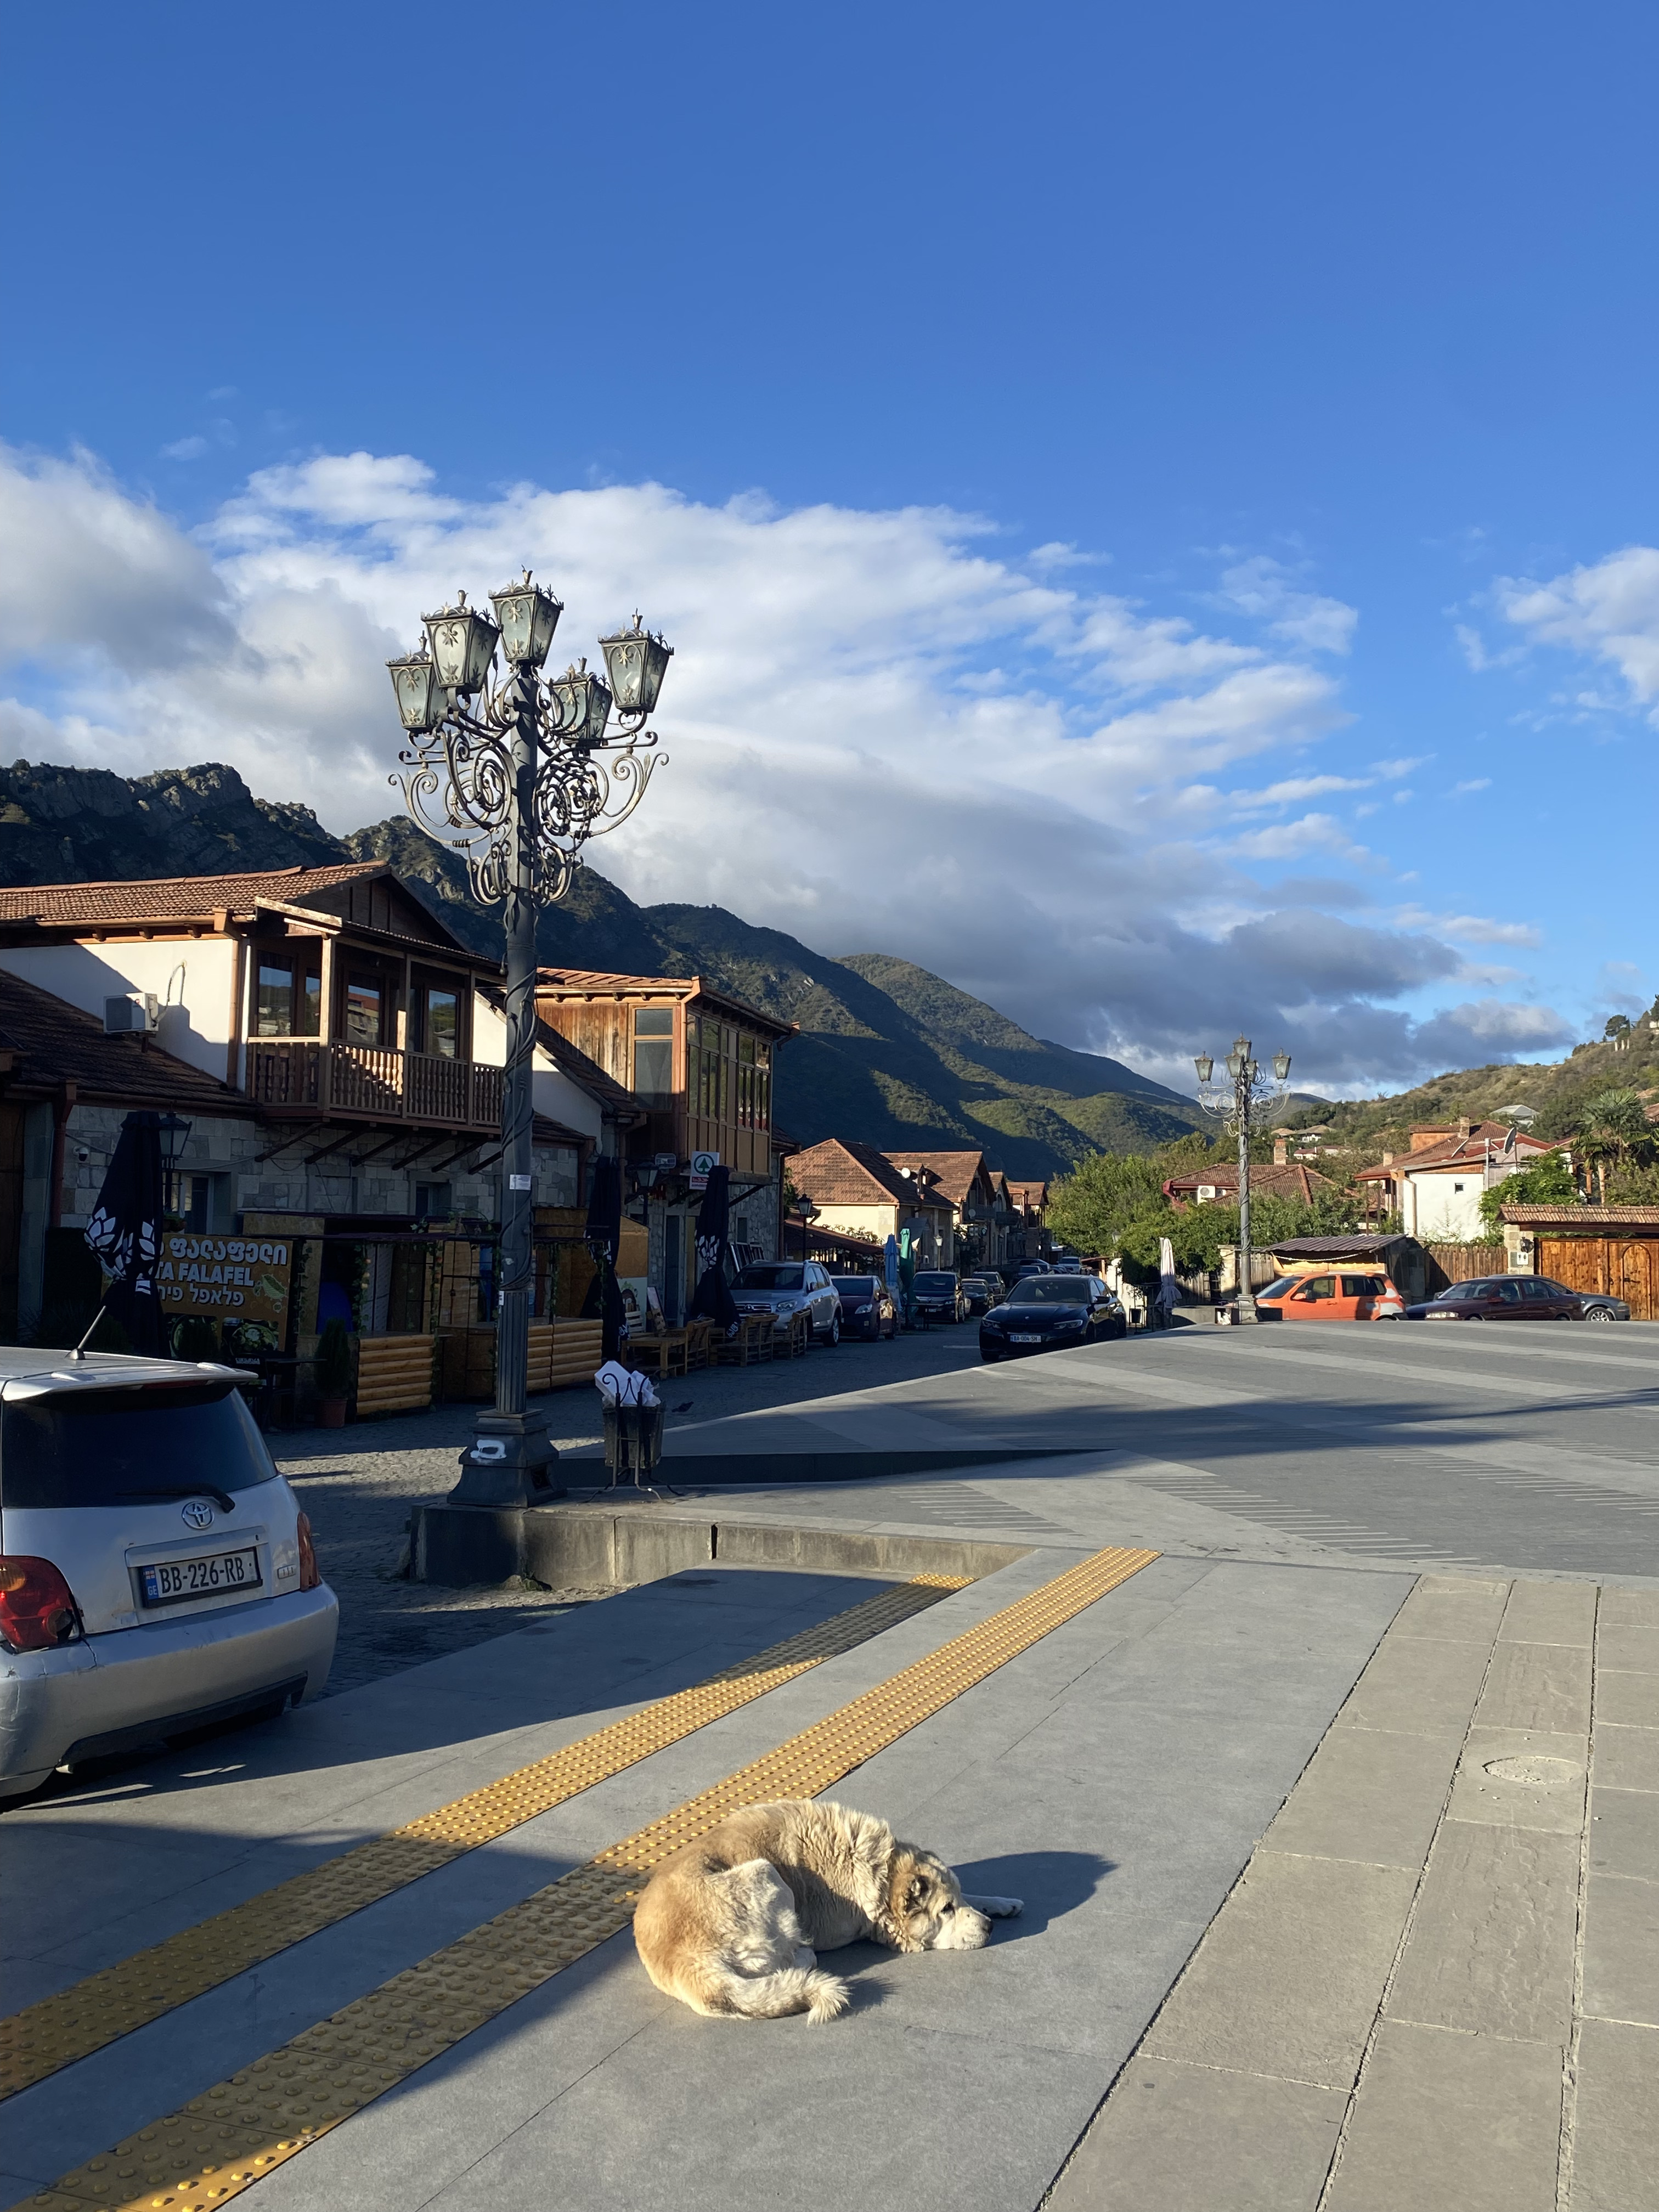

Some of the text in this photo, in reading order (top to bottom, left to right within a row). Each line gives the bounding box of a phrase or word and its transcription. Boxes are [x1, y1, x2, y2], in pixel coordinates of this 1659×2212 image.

[169, 1238, 287, 1266] ფალაფელი
[178, 1263, 255, 1286] FALAFEL
[189, 1283, 245, 1306] פלאפל
[148, 1557, 245, 1596] GE BB-226-RB
